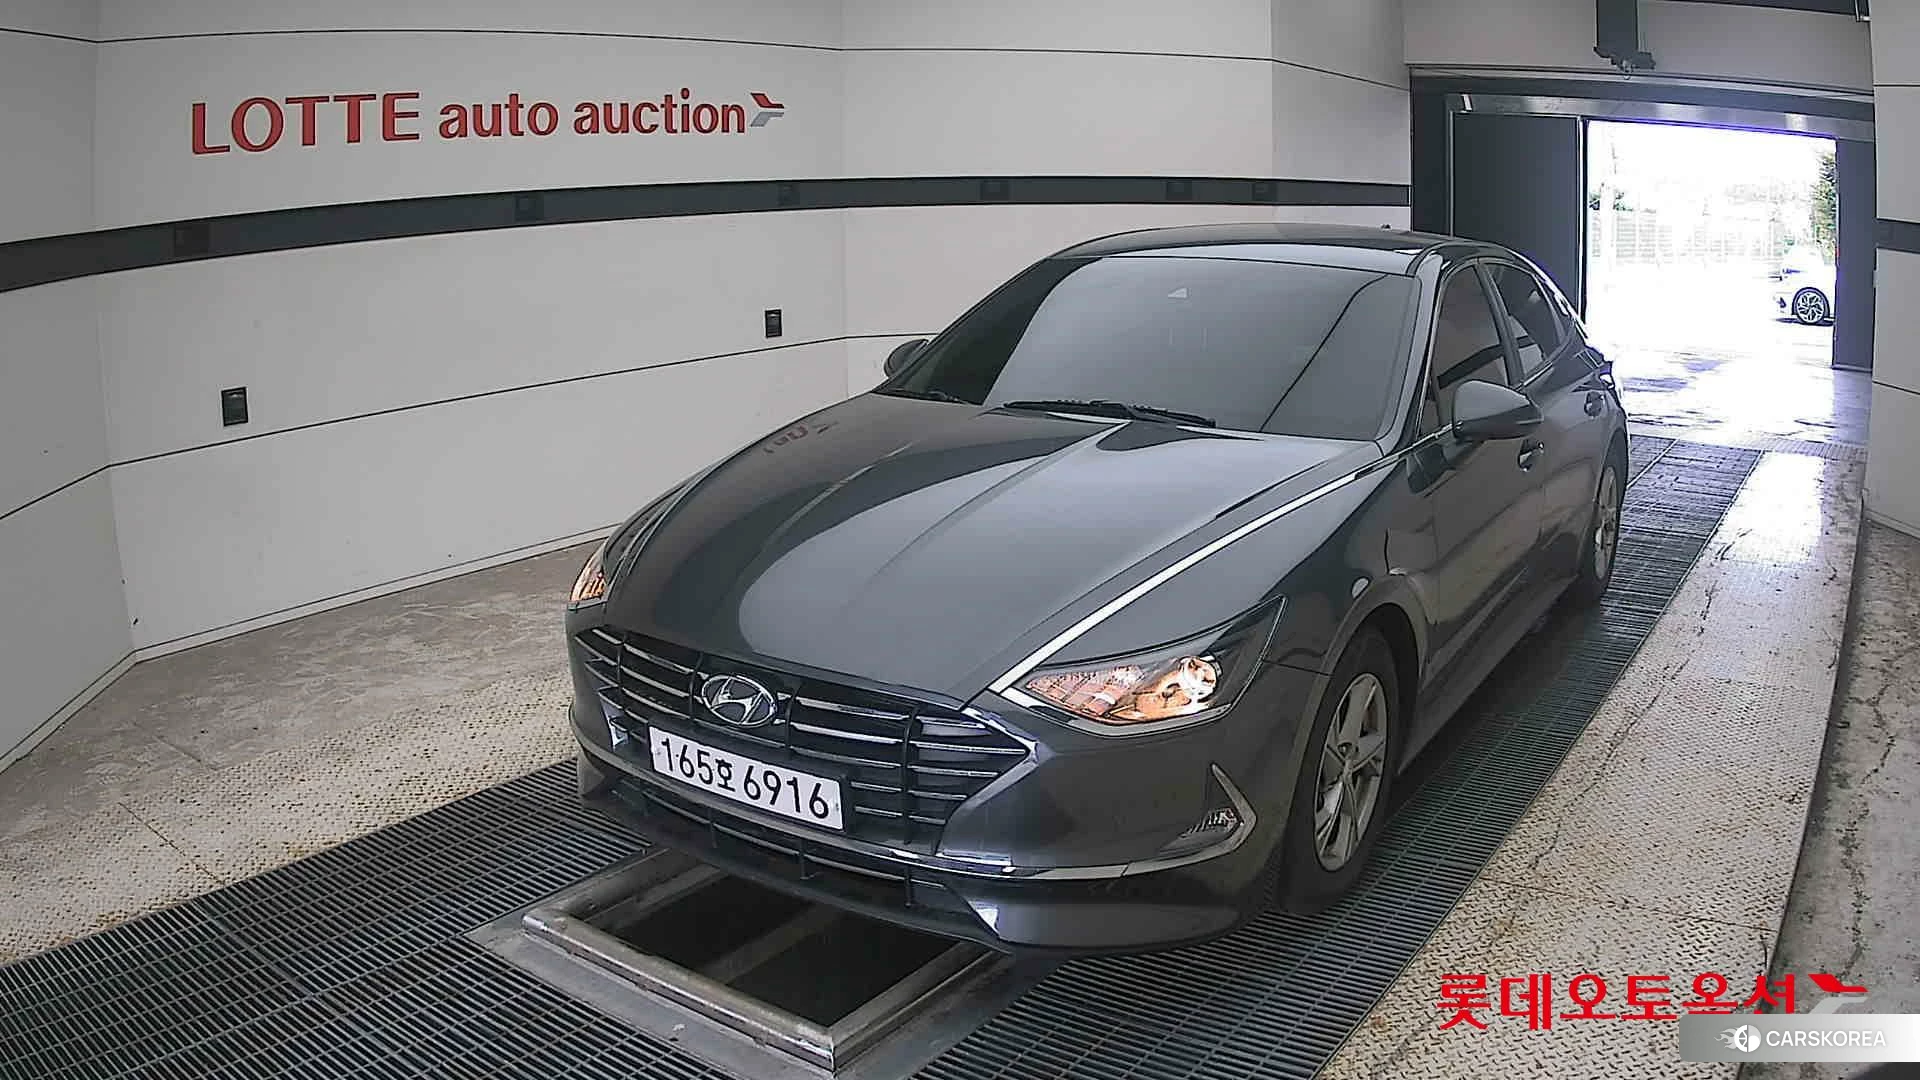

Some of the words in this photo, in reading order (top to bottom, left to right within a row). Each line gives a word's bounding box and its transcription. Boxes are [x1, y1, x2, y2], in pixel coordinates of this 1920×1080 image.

[191, 91, 420, 155] LOTTE
[438, 93, 559, 139] auto
[573, 87, 746, 136] auction
